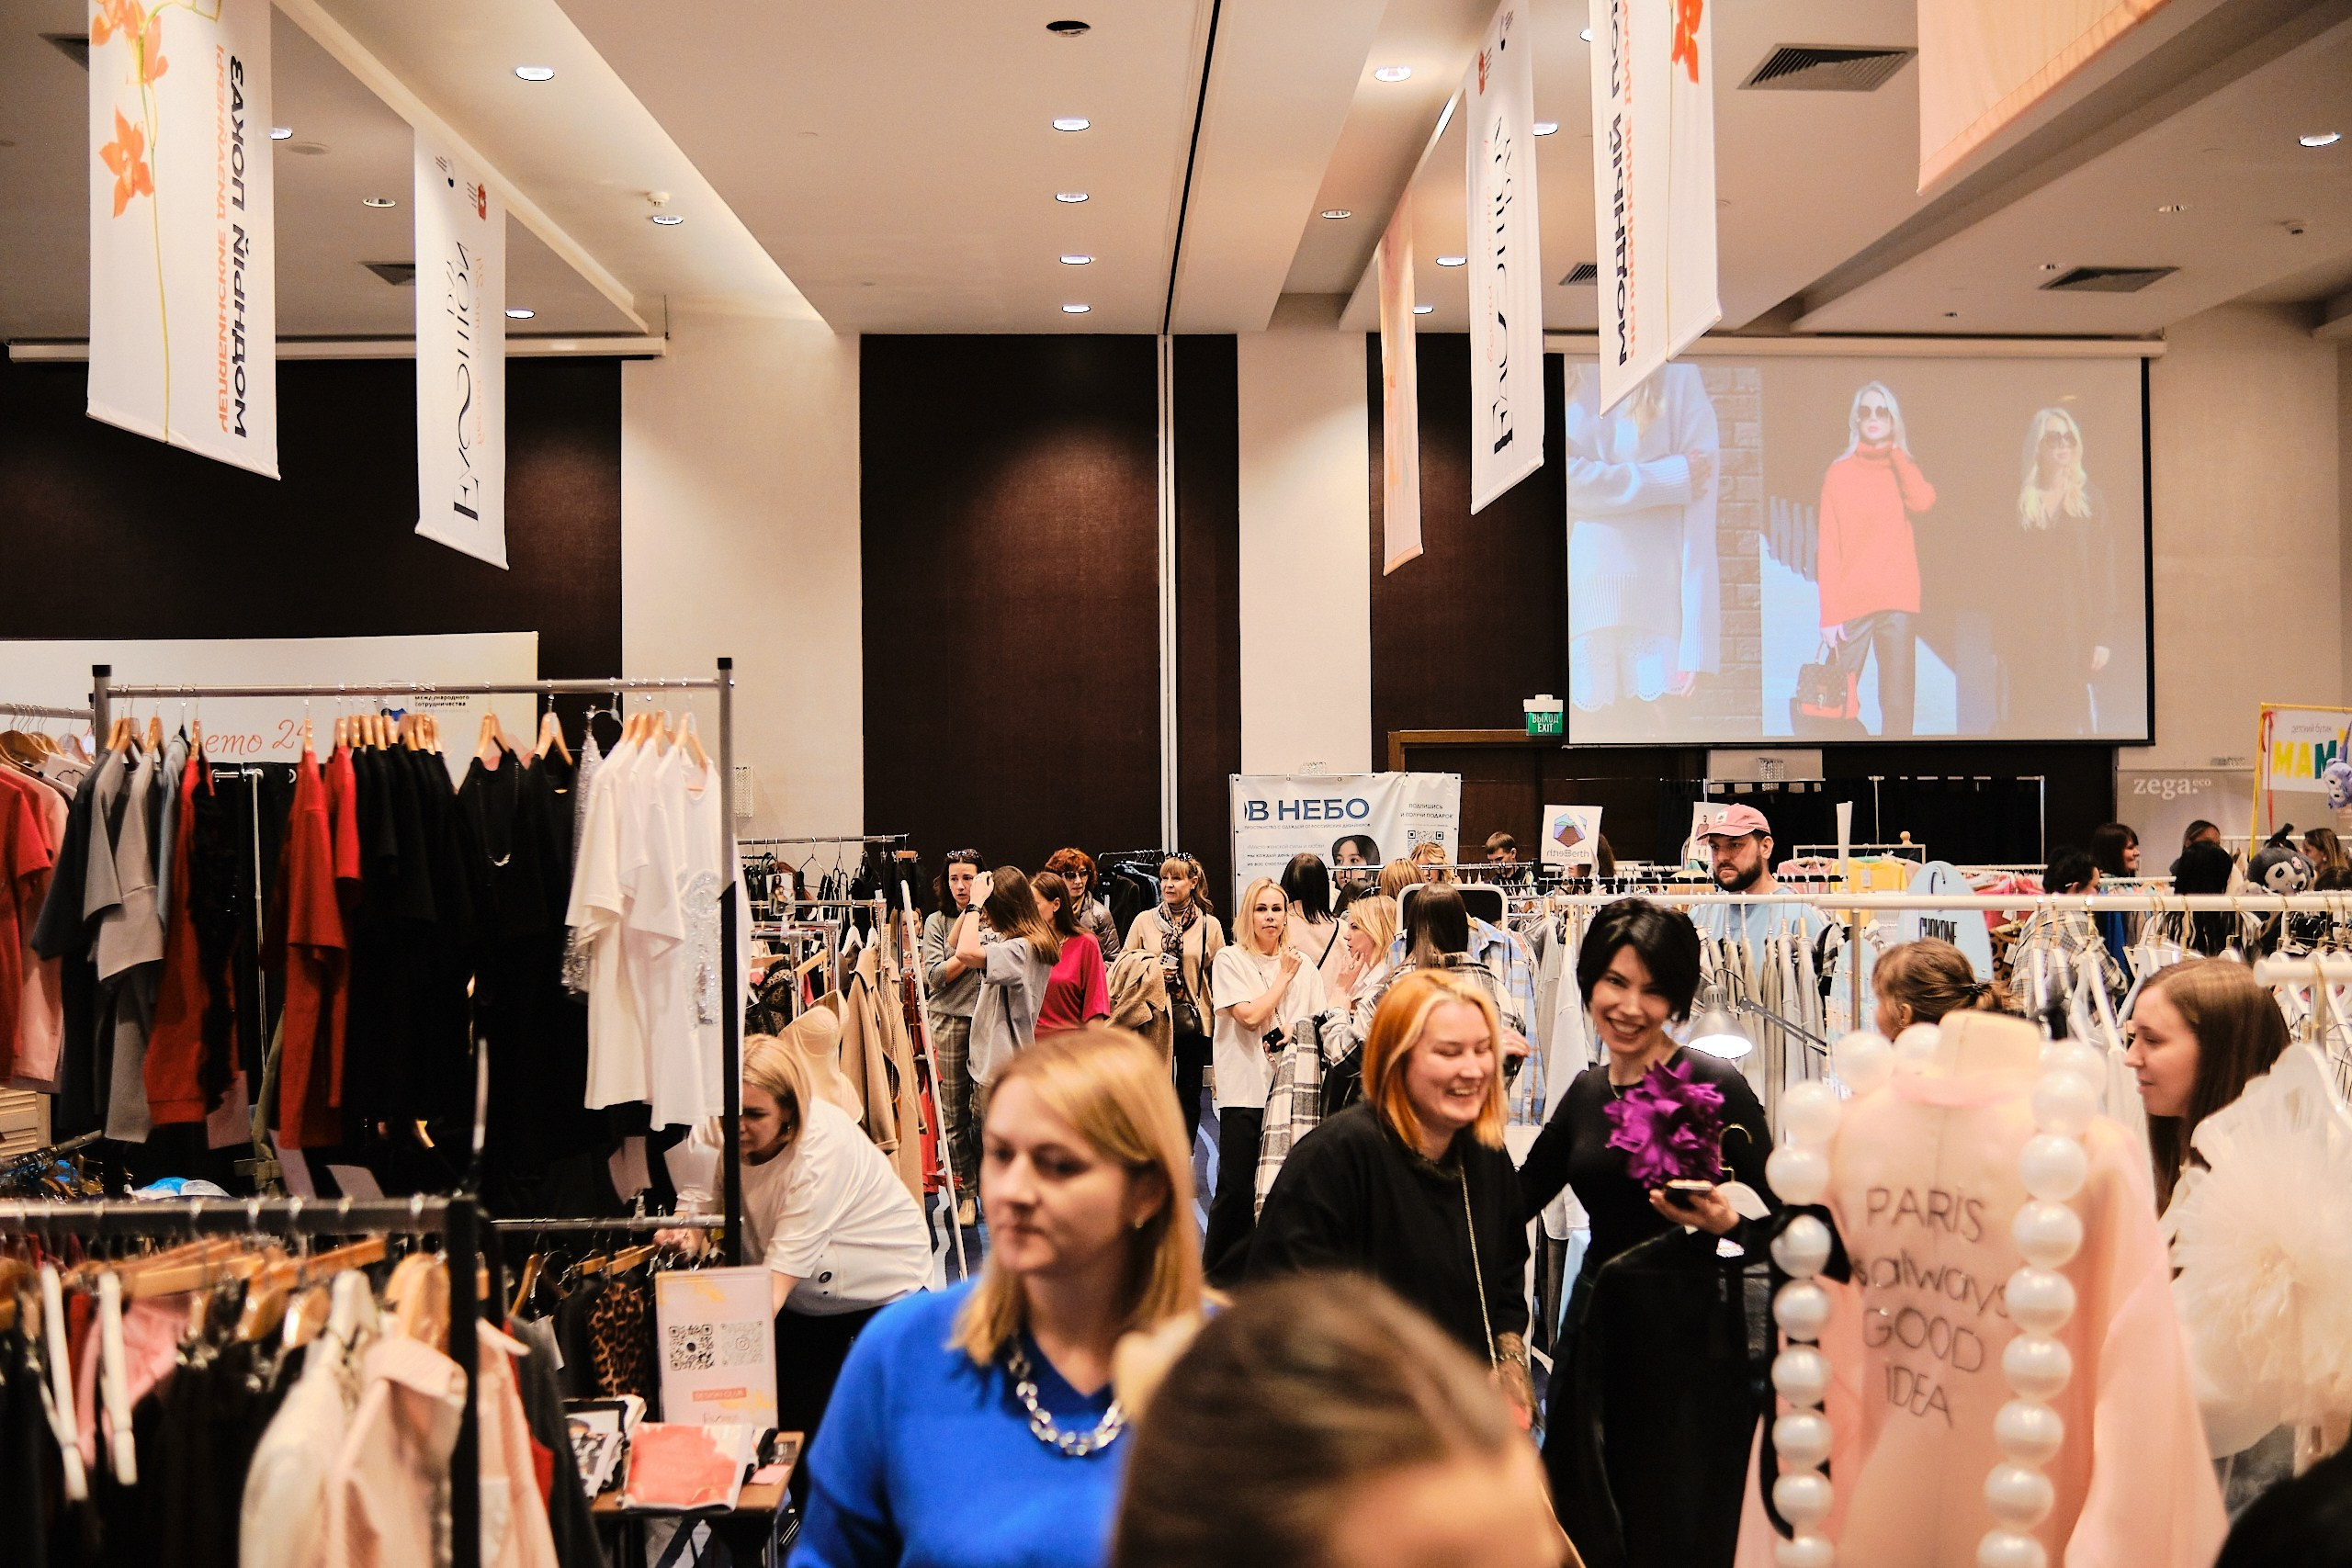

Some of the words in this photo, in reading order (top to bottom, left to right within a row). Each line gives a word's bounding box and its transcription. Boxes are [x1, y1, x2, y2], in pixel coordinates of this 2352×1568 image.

[1610, 112, 1627, 366] МОДНЫЙ
[1624, 115, 1635, 358] ЧЕЛЯБИНСКИЕ
[205, 734, 262, 755] ето
[1532, 713, 1558, 724] ВЫХОД
[1537, 723, 1553, 733] EXIT
[1278, 798, 1370, 820] НЕБО
[1866, 1187, 1985, 1243] PARIS
[1862, 1305, 1984, 1373] GOOD
[1885, 1364, 1953, 1429] IDEA
